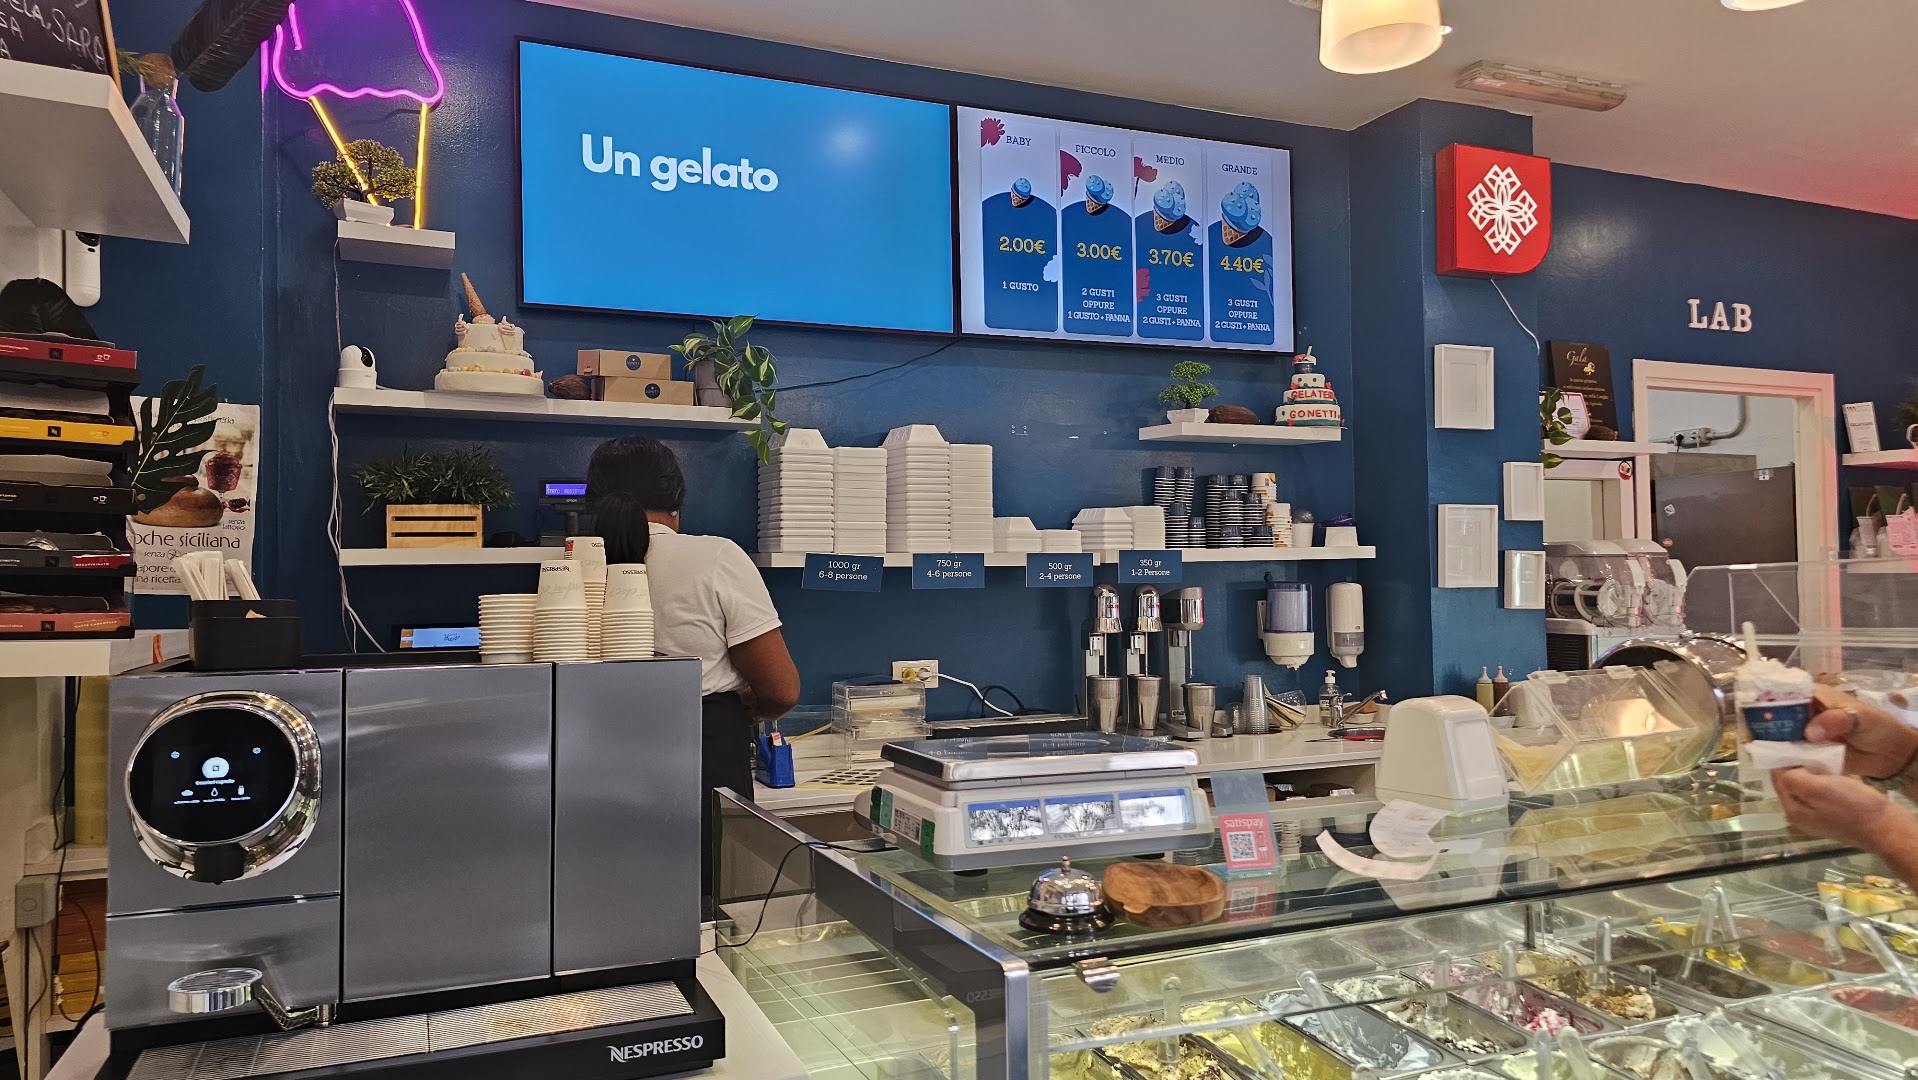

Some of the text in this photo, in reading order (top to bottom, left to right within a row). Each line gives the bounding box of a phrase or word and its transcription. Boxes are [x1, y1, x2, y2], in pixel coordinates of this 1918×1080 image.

[1006, 135, 1031, 146] BABY
[1075, 145, 1116, 157] PICCOLO
[582, 133, 778, 192] Un gelato
[1156, 155, 1185, 165] MEDIO
[1222, 164, 1258, 175] GRANDE
[999, 236, 1046, 254] 2.00€
[1076, 242, 1123, 261] 3.00€
[1148, 248, 1195, 267] 3.70€
[1219, 255, 1264, 274] 4.40€
[1002, 281, 1039, 291] 1 GUSTO
[1081, 287, 1115, 297] 2 GUSTI
[1156, 293, 1188, 303] 3 GUSTI
[1234, 299, 1258, 308] GUSTI
[1082, 300, 1115, 309] OPPURE
[1156, 305, 1188, 315] OPPURE
[1073, 311, 1099, 320] GUSTO
[1105, 314, 1131, 323] PANNA
[1228, 310, 1258, 319] OPPURE
[1687, 298, 1753, 333] LAB
[1142, 316, 1148, 324] 2
[1148, 316, 1172, 326] GUSTI
[1176, 319, 1201, 328] PANNA
[1215, 321, 1221, 329] 2
[1220, 321, 1242, 330] GUSTI
[1247, 323, 1271, 332] PANNA
[1566, 347, 1588, 366] Gala
[1289, 409, 1337, 419] GONETTI
[179, 532, 240, 548] siciliana
[144, 550, 165, 558] senza
[828, 560, 861, 571] 1000 gr
[1139, 559, 1163, 568] 350 gr
[818, 571, 868, 581] 6-8 persone
[926, 570, 972, 579] 4-6 persone
[1039, 572, 1082, 581] 2-4 persone
[1224, 817, 1264, 829] satispay
[605, 1035, 704, 1063] NESPRESSO
